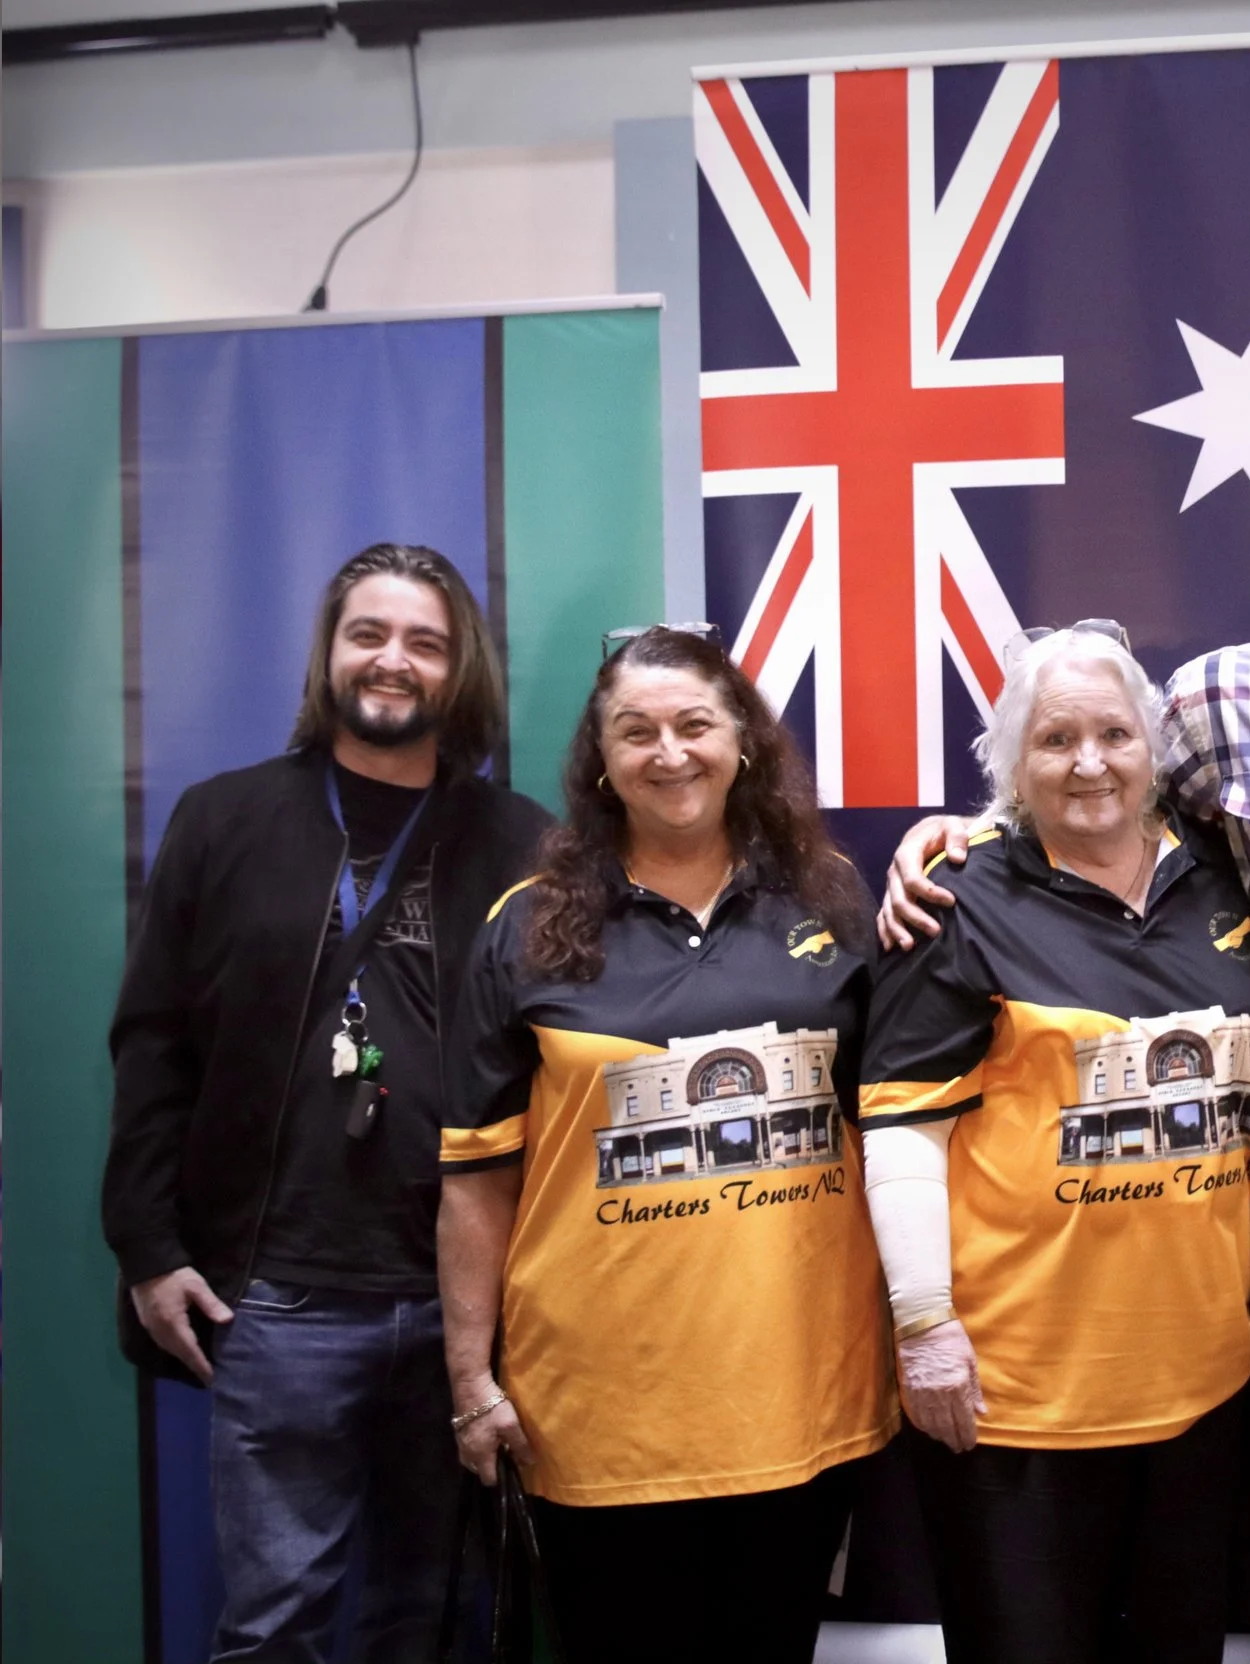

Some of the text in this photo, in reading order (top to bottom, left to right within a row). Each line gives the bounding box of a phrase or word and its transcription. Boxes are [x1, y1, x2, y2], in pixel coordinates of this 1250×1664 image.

[596, 1167, 845, 1225] Charters Towers NQ
[1055, 1179, 1164, 1205] Charters
